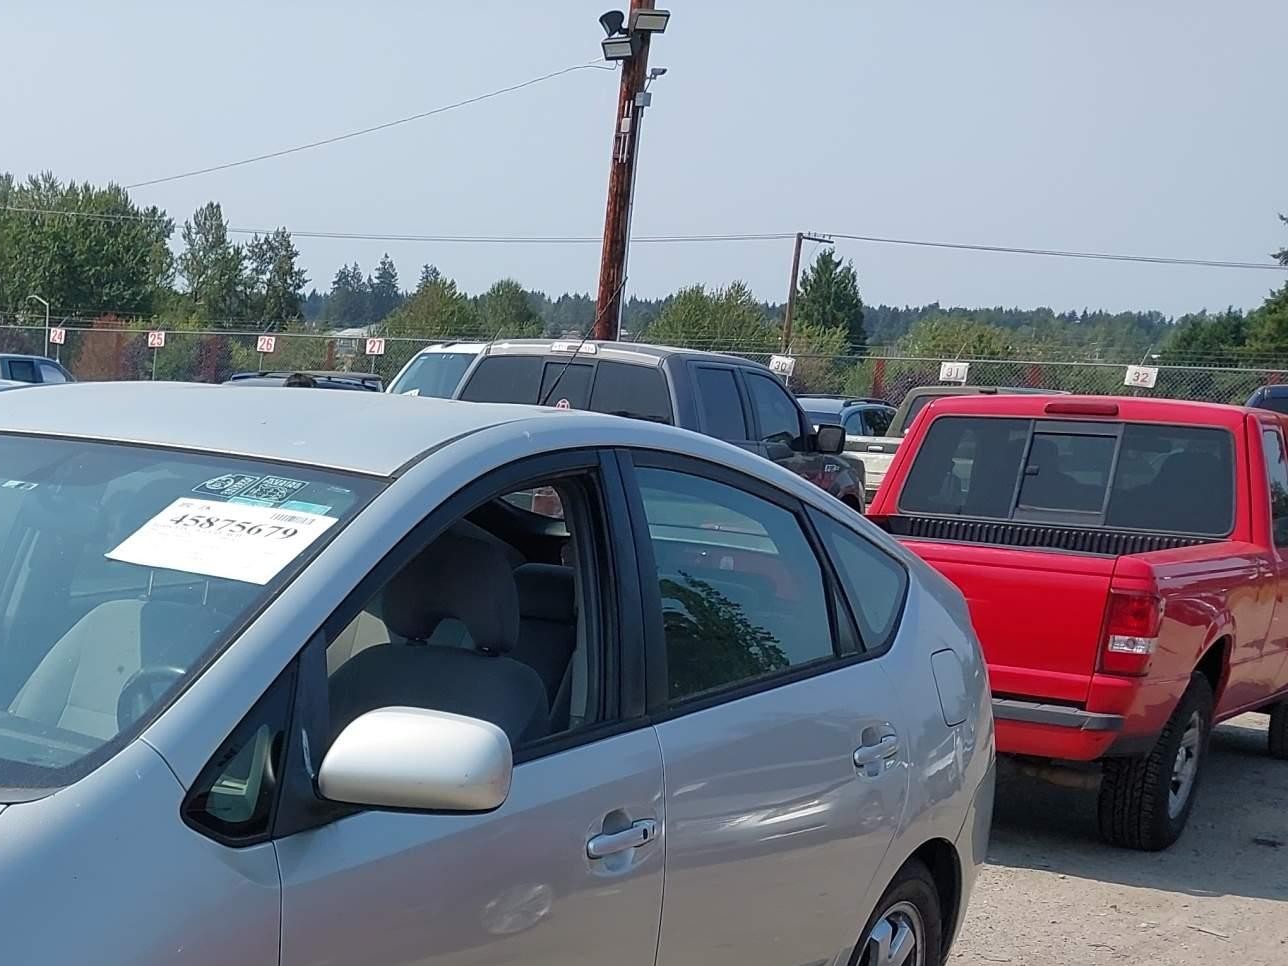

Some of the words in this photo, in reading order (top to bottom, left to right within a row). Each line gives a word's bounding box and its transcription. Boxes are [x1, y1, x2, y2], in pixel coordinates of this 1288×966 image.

[53, 329, 63, 342] 24
[150, 333, 163, 345] 25
[259, 338, 273, 350] 26
[369, 340, 383, 353] 27
[775, 362, 787, 371] 30
[947, 367, 959, 377] 31
[1133, 372, 1149, 382] 32
[170, 514, 298, 539] 45875679
